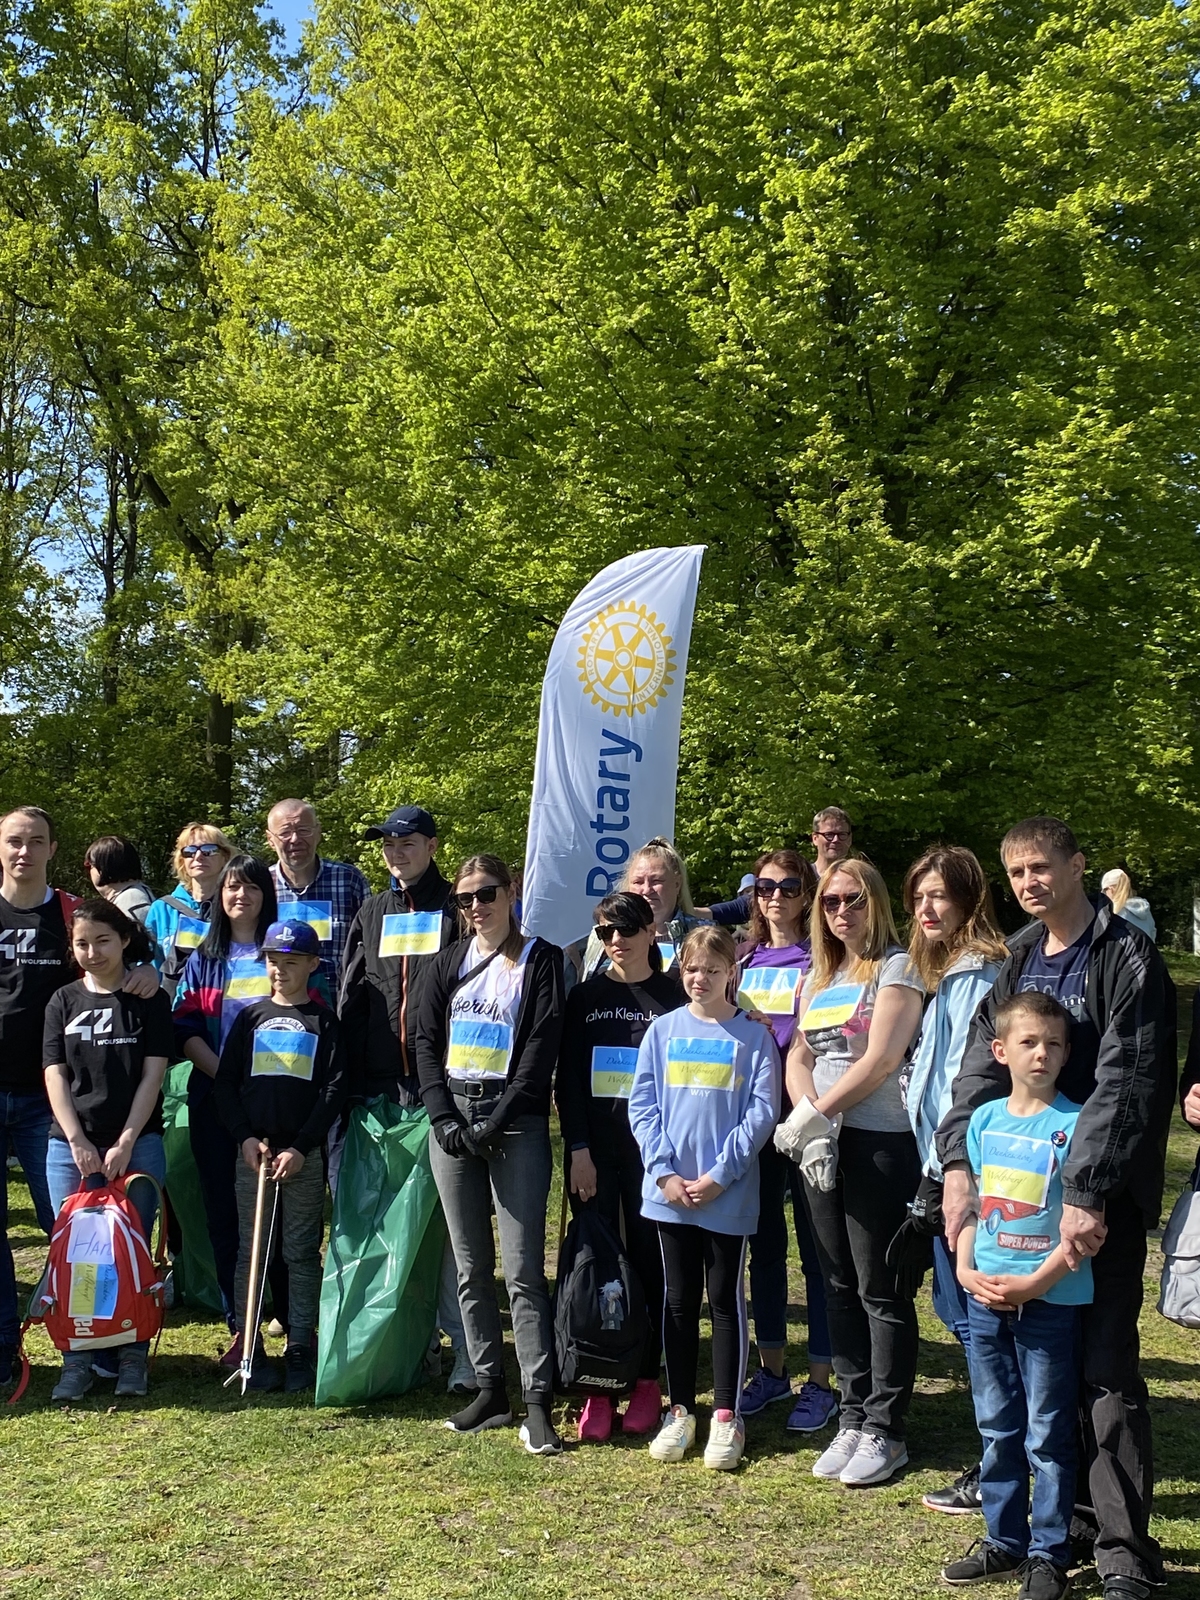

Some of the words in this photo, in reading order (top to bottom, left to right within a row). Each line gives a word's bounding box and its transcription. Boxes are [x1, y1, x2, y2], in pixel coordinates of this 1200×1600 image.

[586, 629, 603, 677] ROTARY
[635, 621, 665, 702] INTERNATIONAL
[586, 728, 643, 897] Rotary
[0, 929, 36, 959] 42
[20, 958, 62, 966] WOLFSBURG
[65, 1008, 113, 1041] 42
[615, 1007, 644, 1021] Klein
[97, 1037, 138, 1046] WOLFSBURG
[690, 1089, 711, 1098] WAY
[999, 1233, 1023, 1248] SUPER
